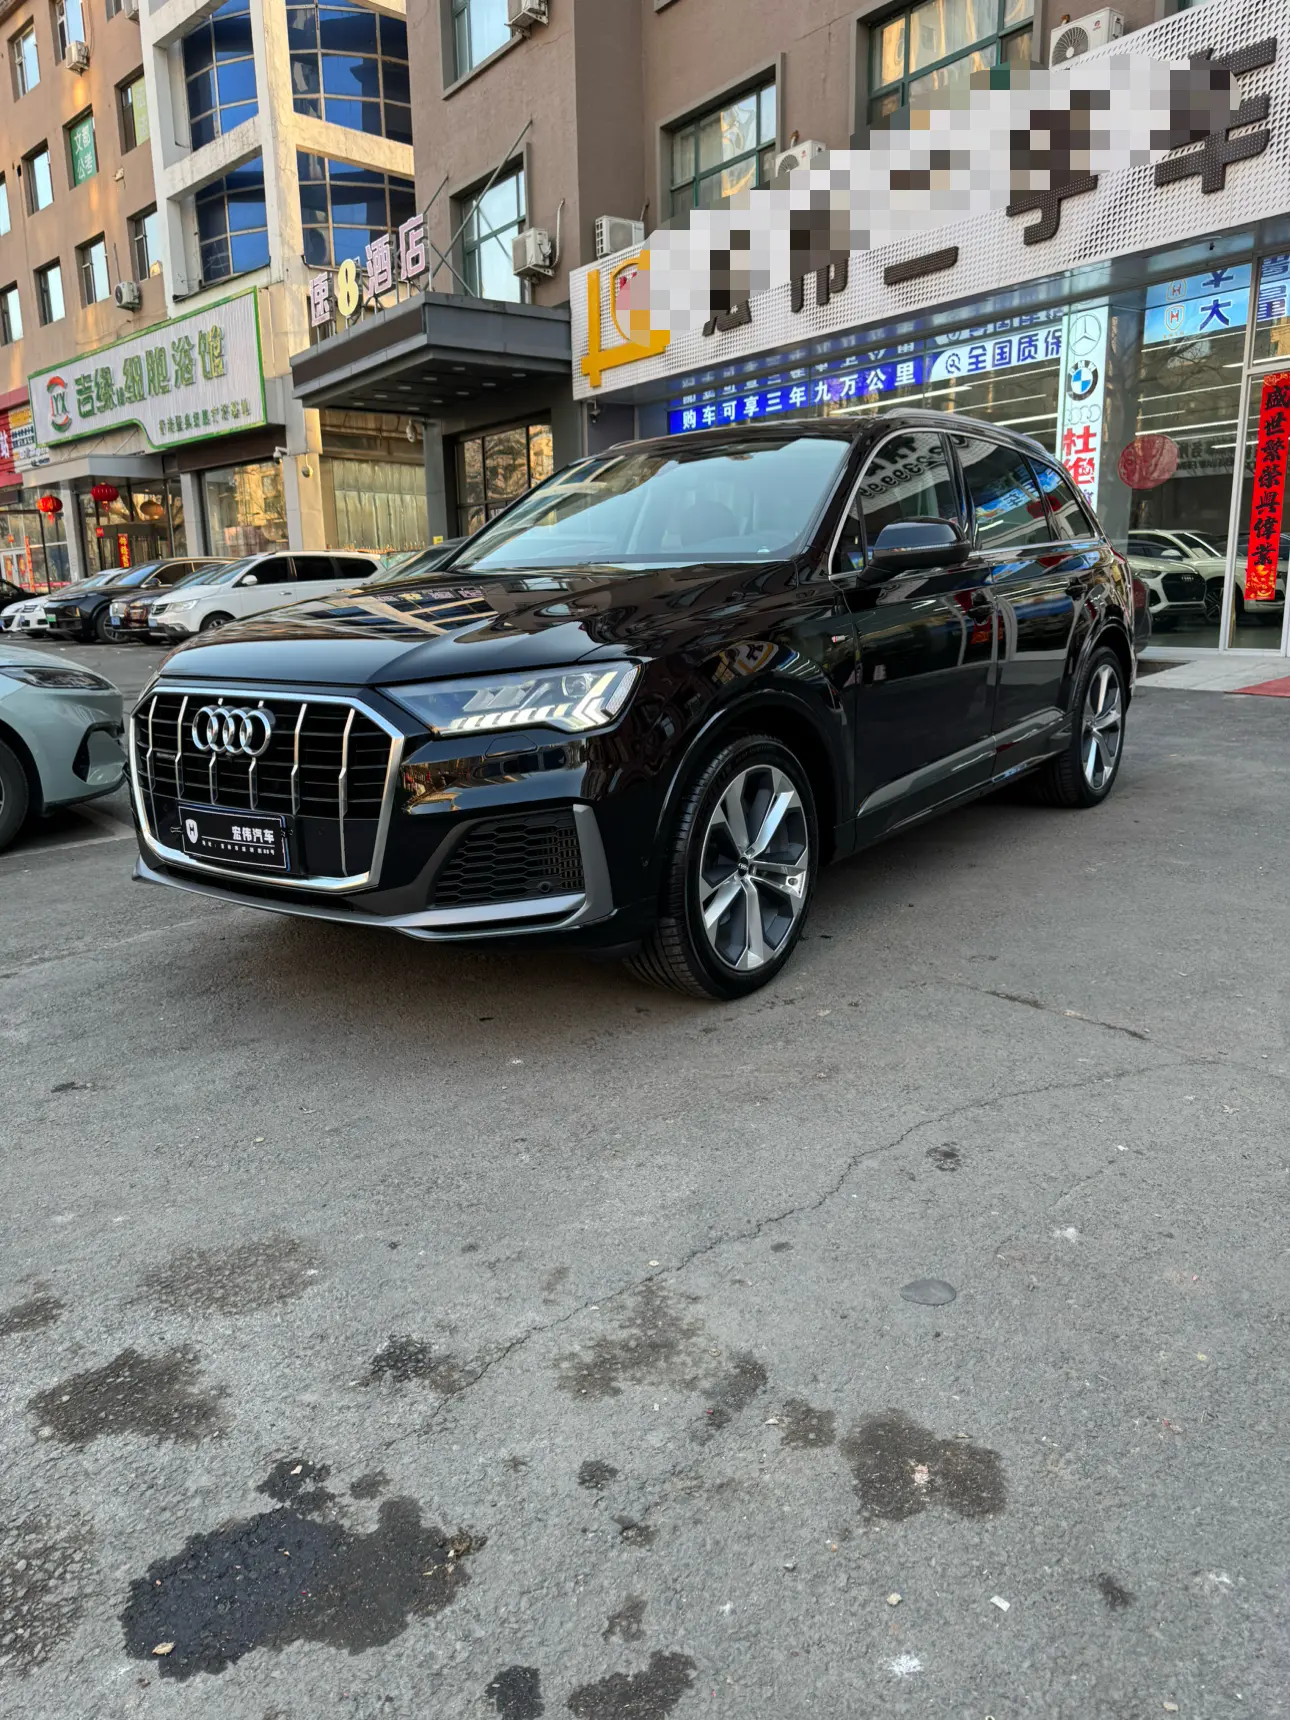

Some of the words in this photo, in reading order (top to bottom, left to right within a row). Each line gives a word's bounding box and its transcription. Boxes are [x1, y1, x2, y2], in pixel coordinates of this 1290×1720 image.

[74, 125, 91, 155] 文都
[77, 151, 93, 180] 公考
[309, 214, 426, 327] 速8酒店
[1199, 299, 1231, 331] 大
[967, 329, 1062, 373] 全国质保
[683, 361, 916, 430] 购车可享三年九万公里
[231, 826, 275, 843] 宏伟汽车
